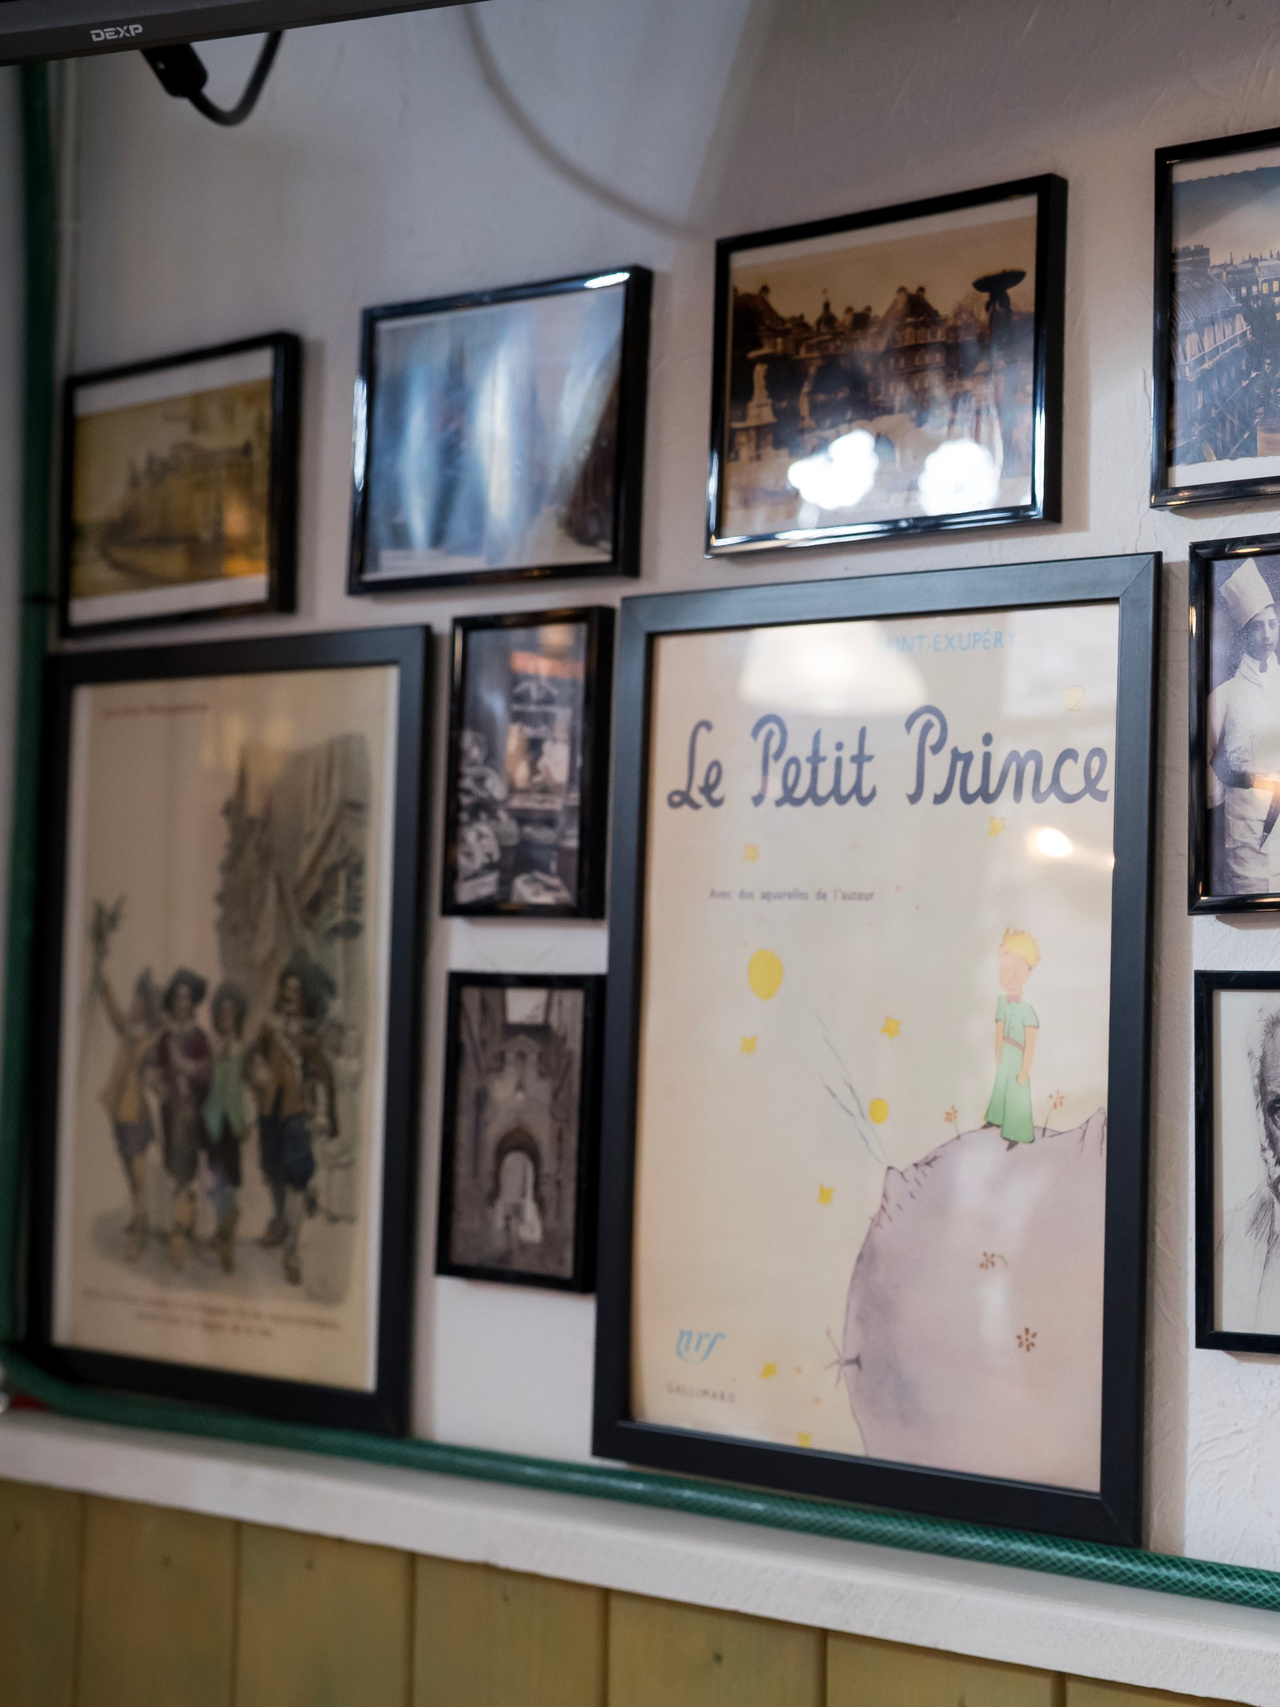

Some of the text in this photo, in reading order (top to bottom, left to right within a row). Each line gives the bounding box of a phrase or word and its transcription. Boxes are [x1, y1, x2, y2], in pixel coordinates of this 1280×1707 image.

[90, 24, 143, 42] DEXP
[884, 628, 1016, 653] INT-EXUPÉRY
[667, 705, 1110, 811] Le Petit Prince
[708, 887, 874, 903] Avec des aquarelles de l'auteur
[675, 1329, 726, 1365] nrf
